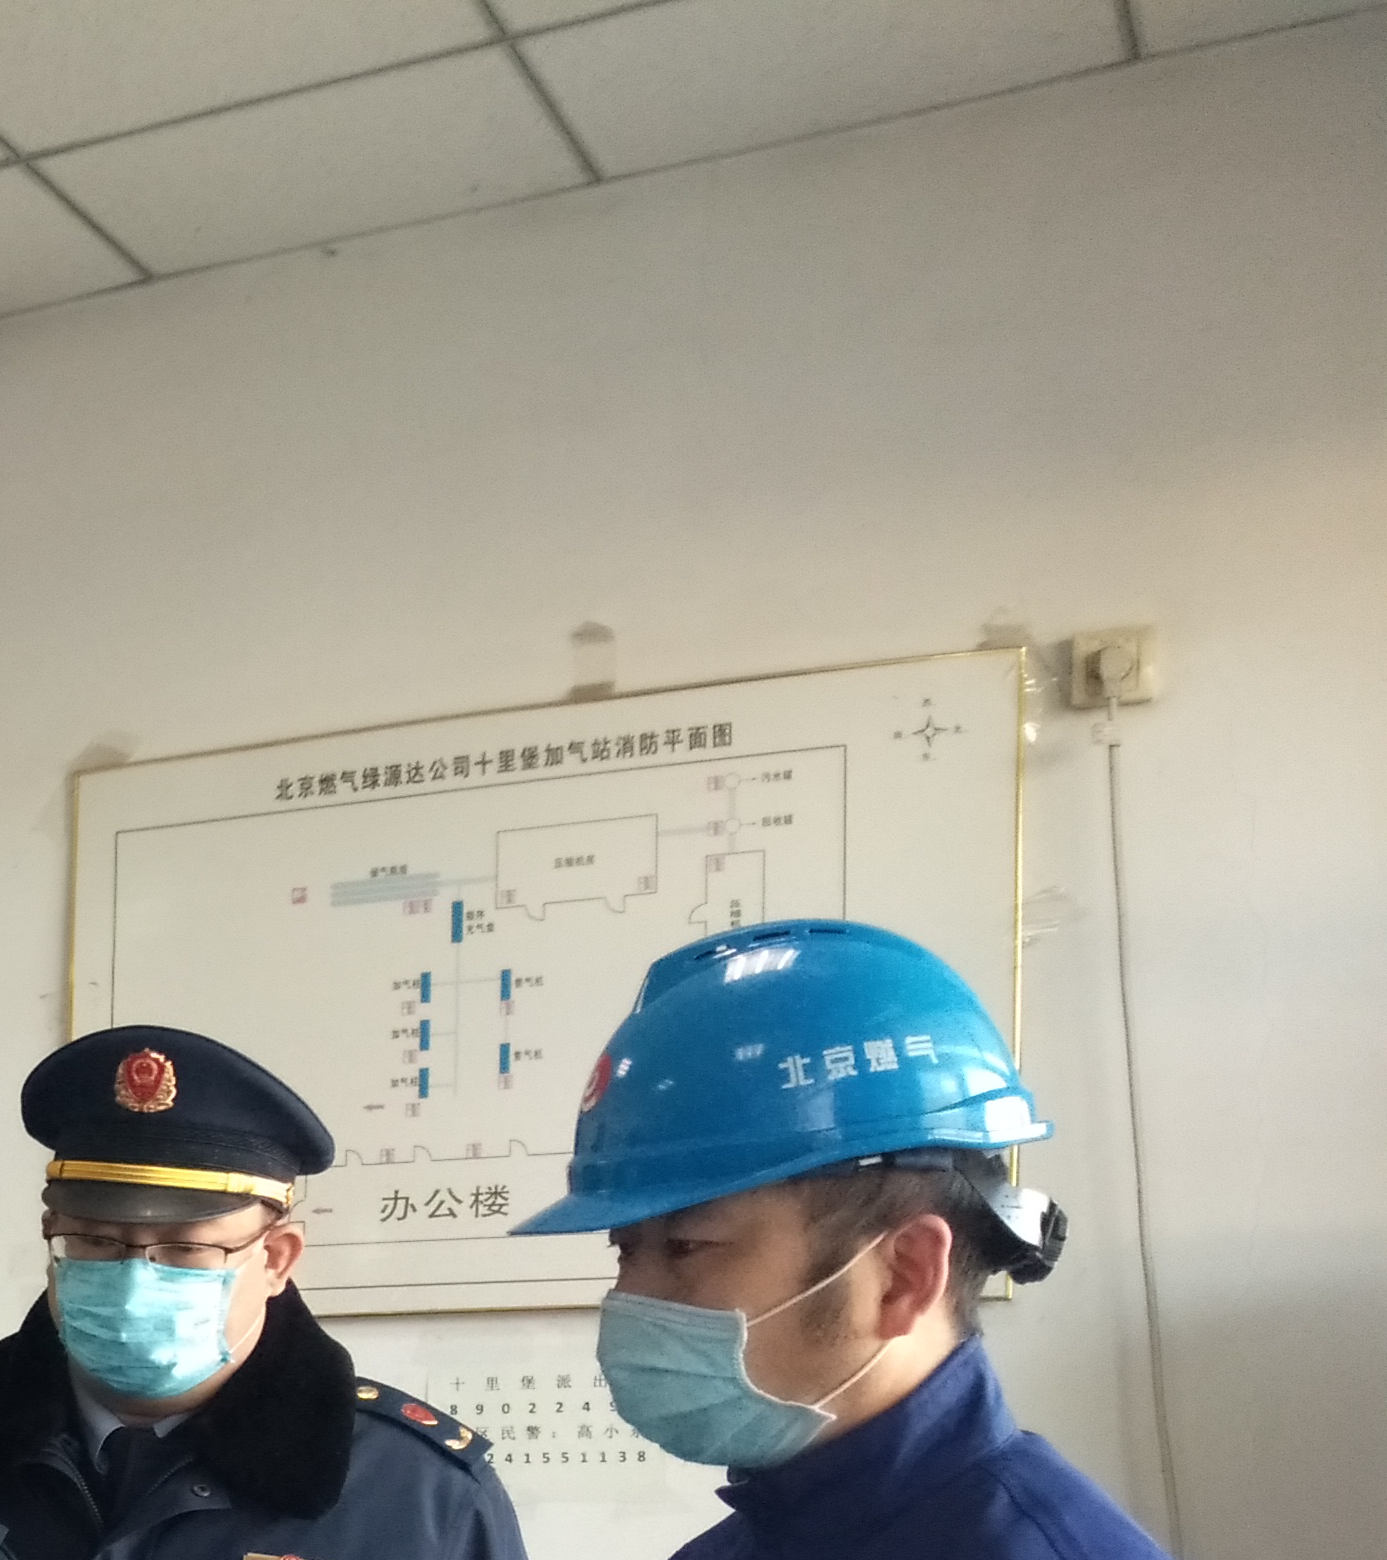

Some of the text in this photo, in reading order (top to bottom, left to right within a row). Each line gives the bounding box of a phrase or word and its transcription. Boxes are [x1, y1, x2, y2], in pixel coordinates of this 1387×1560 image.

[275, 721, 734, 802] 北京燃气绿源达公司十里堡加气站消防平面图
[778, 1035, 939, 1089] 北京燃气
[379, 1184, 510, 1223] 办公楼
